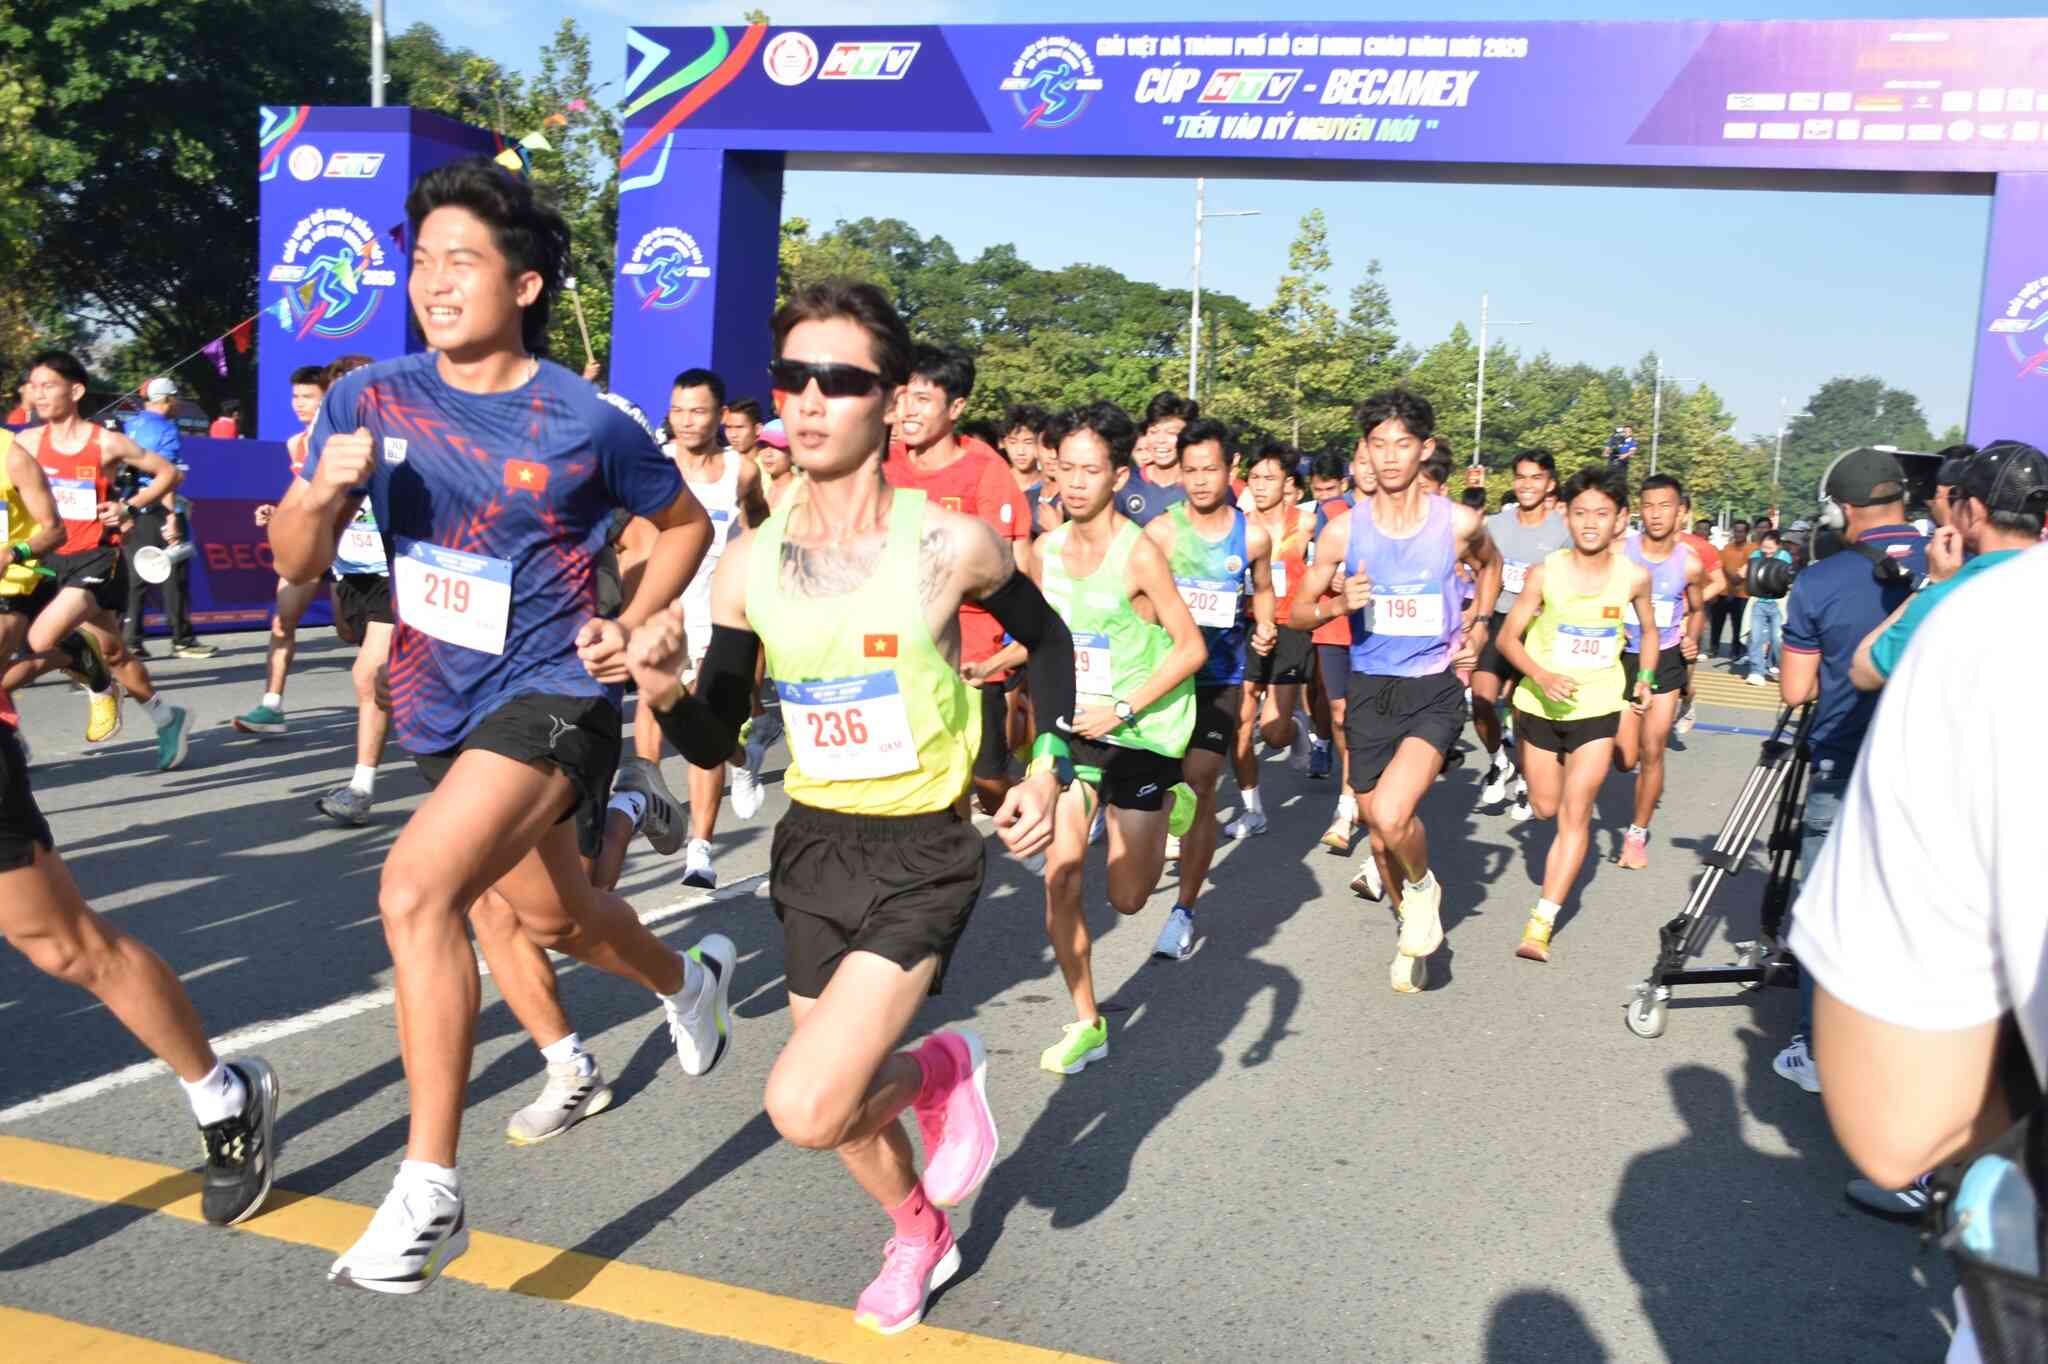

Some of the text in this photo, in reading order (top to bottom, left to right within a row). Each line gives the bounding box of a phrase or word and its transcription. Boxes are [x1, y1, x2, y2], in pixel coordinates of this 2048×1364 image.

[823, 44, 917, 78] HTV
[1134, 61, 1202, 103] CÚP
[1201, 70, 1301, 102] HTV
[1319, 68, 1480, 107] BECAMEX
[424, 573, 470, 614] 219
[1189, 592, 1217, 611] 202
[1385, 599, 1417, 618] 196
[1571, 639, 1600, 655] 240
[807, 708, 869, 748] 236
